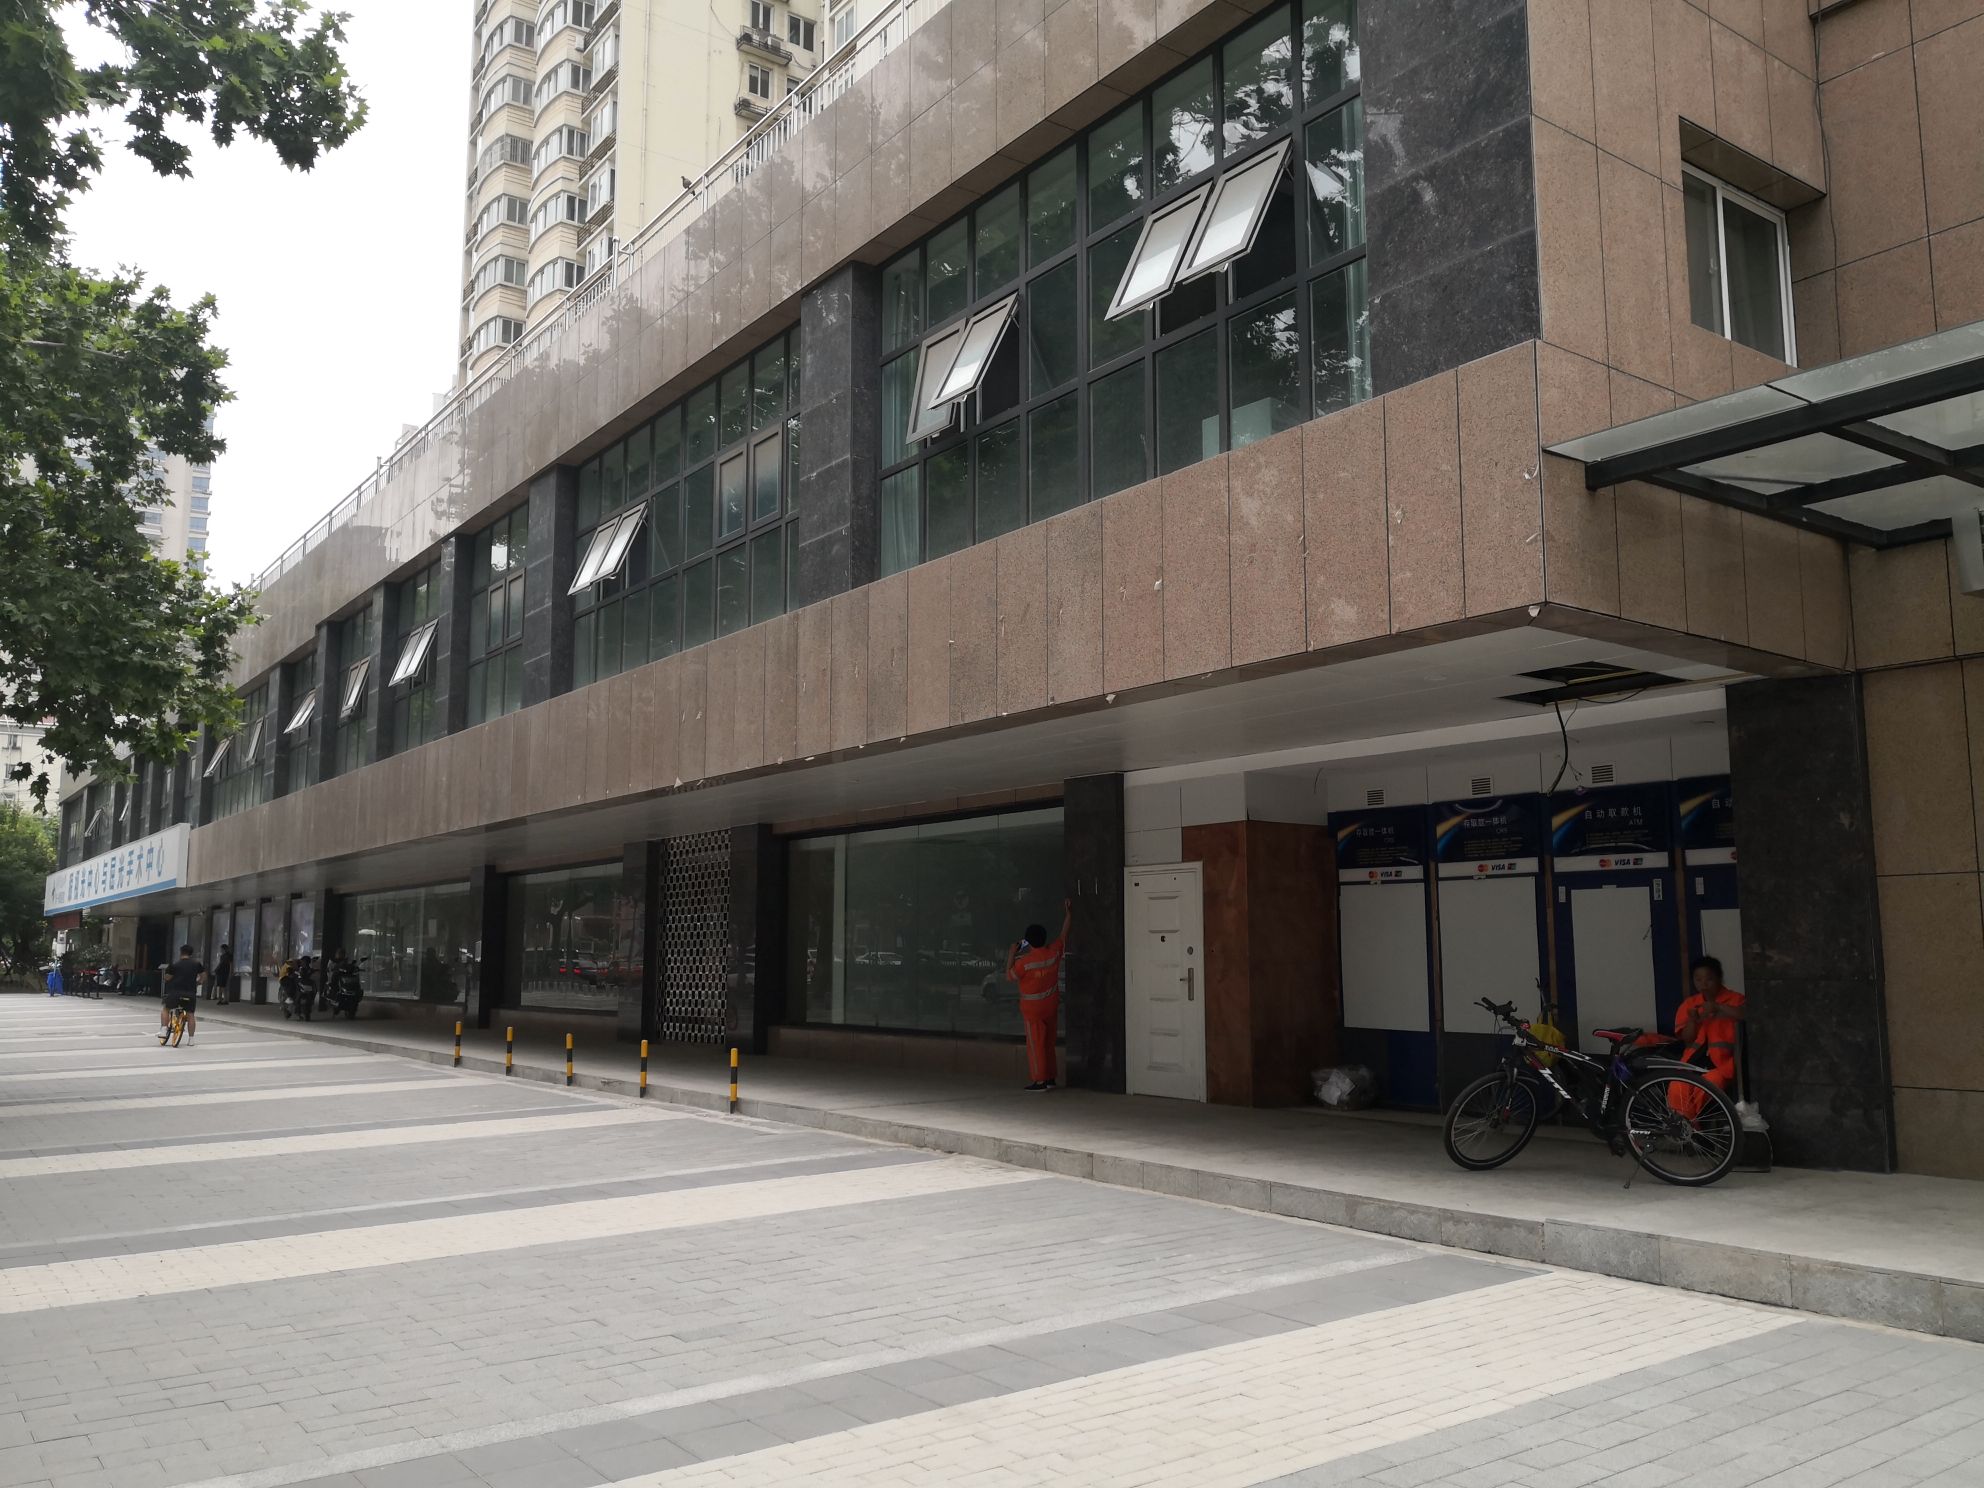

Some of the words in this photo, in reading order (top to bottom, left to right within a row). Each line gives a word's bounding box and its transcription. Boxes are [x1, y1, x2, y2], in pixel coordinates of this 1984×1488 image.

[1585, 805, 1642, 820] 自动取款机
[1464, 816, 1507, 829] 存取款一体机
